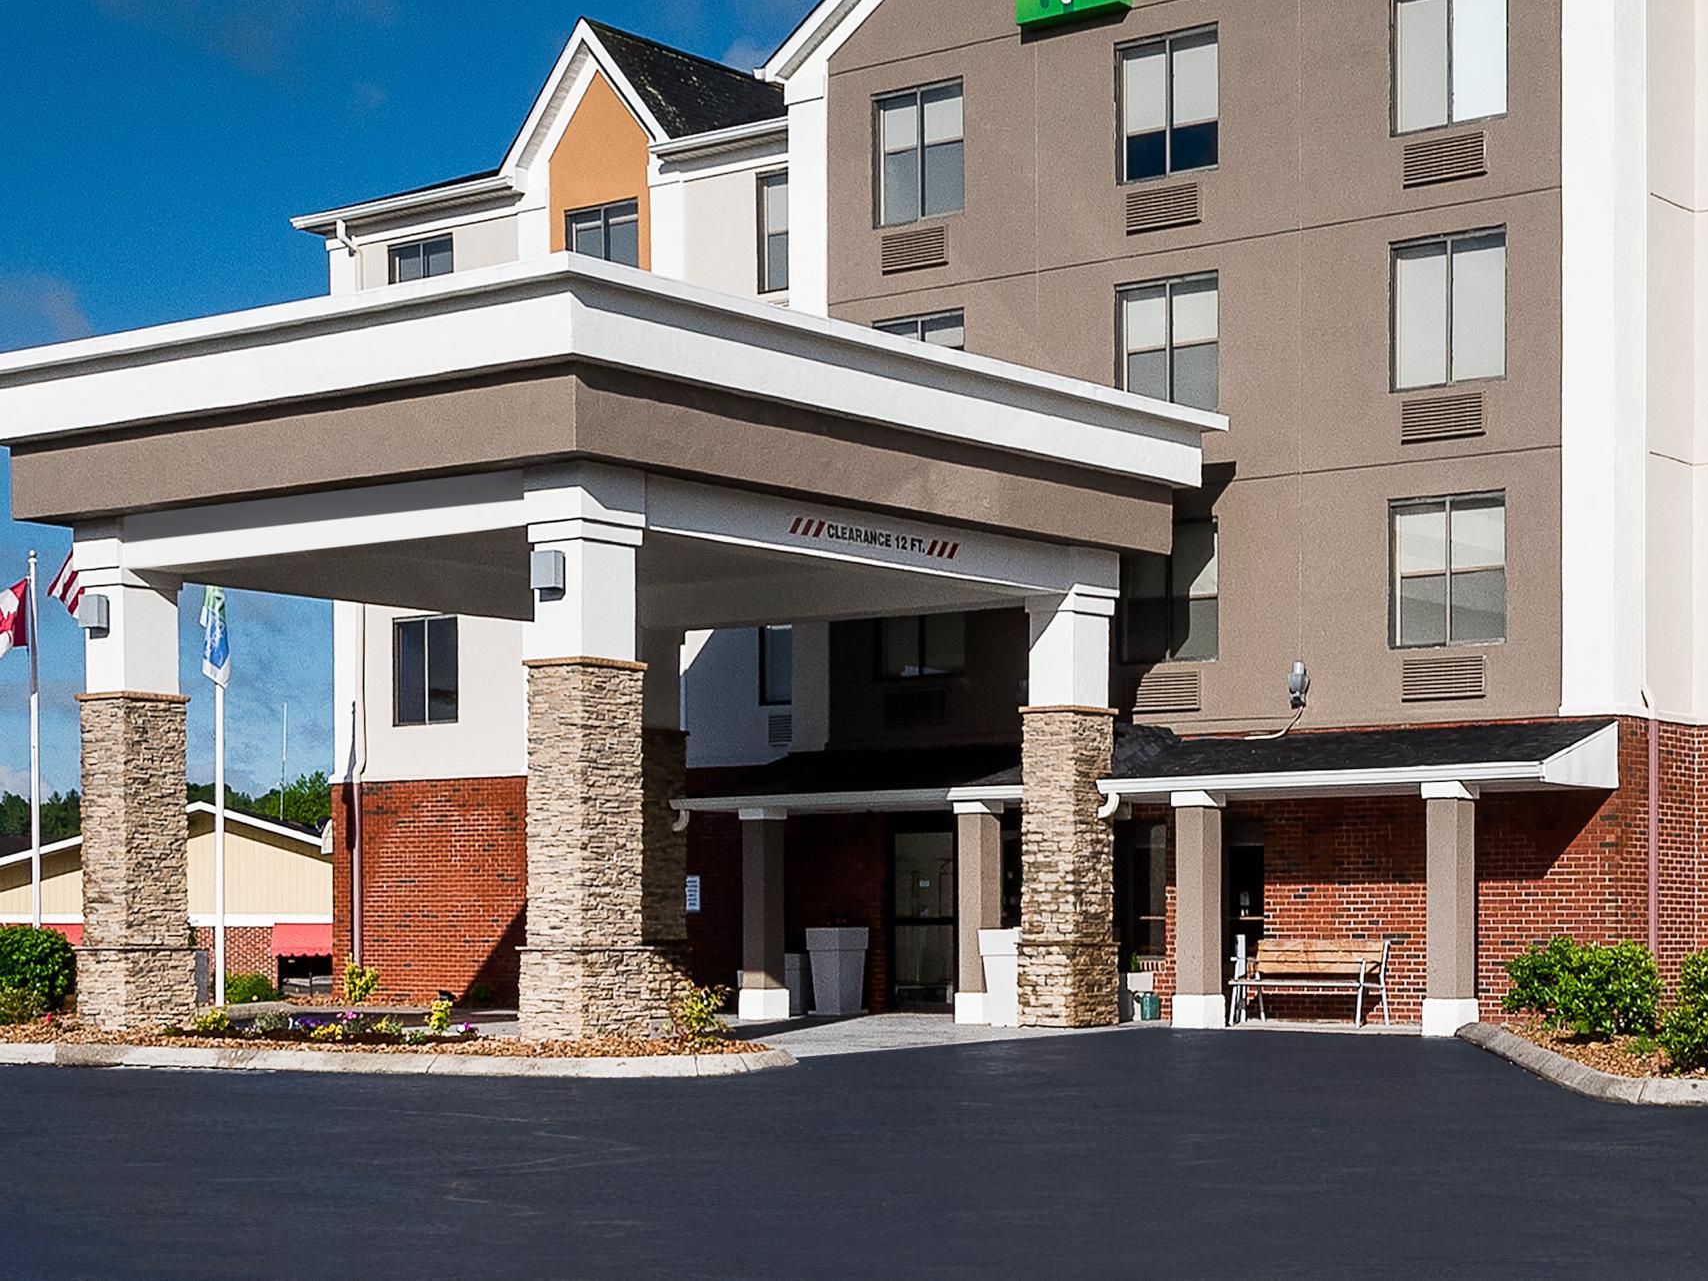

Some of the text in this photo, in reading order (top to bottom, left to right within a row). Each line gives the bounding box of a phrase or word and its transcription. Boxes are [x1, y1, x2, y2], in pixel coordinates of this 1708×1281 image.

[826, 524, 926, 554] CLEARANCE 12 FT.
